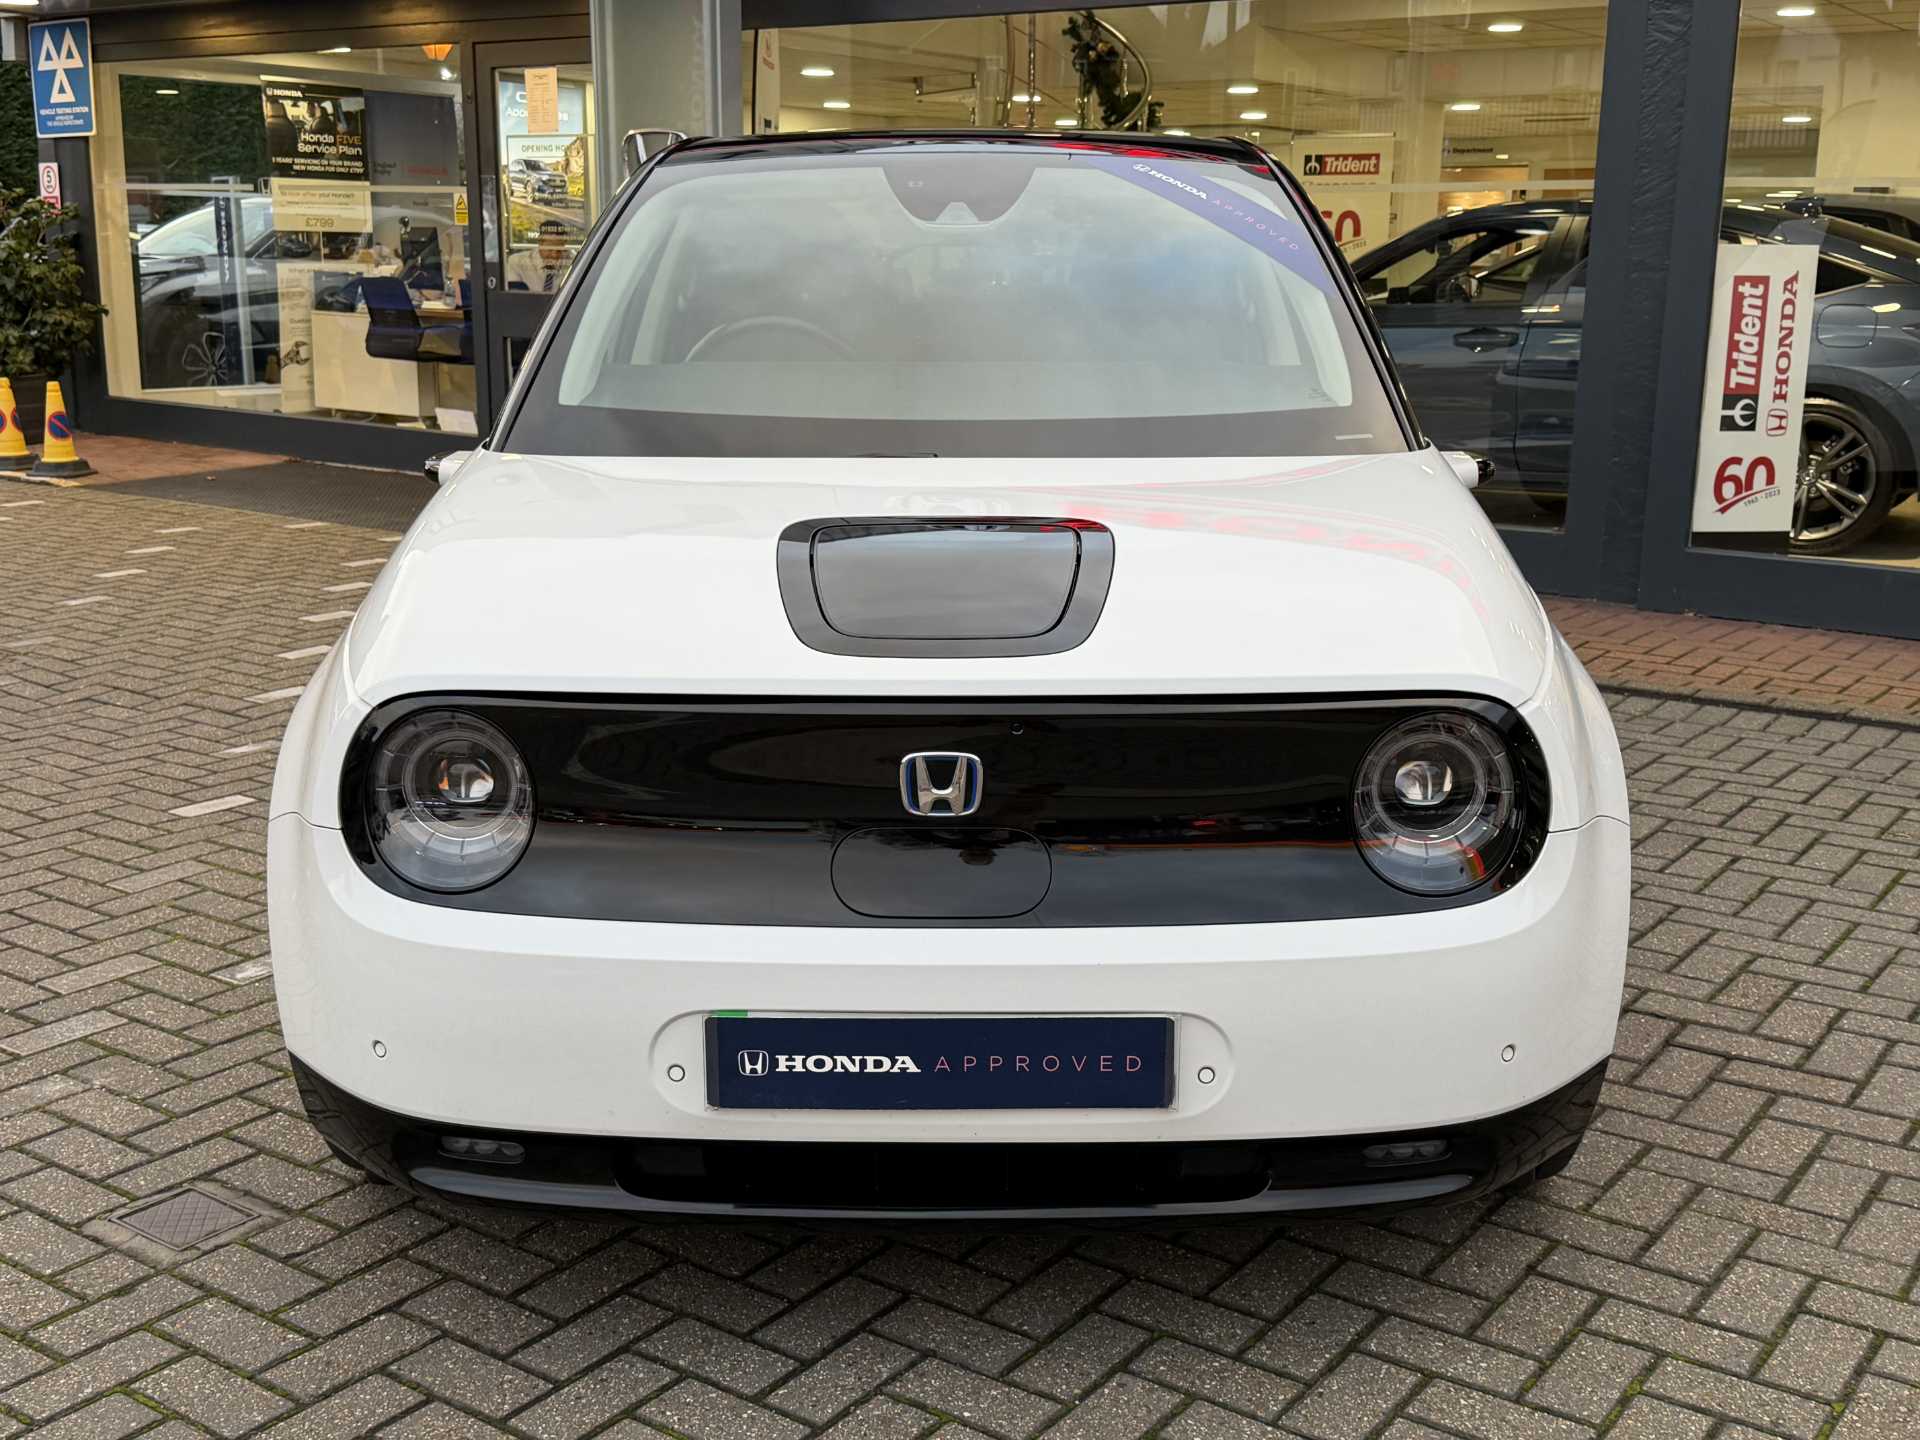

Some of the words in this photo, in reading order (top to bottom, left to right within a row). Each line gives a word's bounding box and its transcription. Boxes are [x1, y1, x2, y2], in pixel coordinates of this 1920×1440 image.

[273, 88, 303, 97] HONDA
[300, 132, 335, 143] Honda
[336, 135, 362, 145] FIVE
[297, 142, 337, 154] Service
[338, 145, 363, 155] Plan
[521, 144, 554, 152] OPENING
[1324, 155, 1378, 173] Trident
[1148, 168, 1208, 200] HONDA
[1211, 198, 1299, 250] APPROVED
[1728, 281, 1765, 390] Trident
[1772, 269, 1800, 403] HONDA
[775, 1054, 922, 1073] HONDA
[934, 1055, 1143, 1072] APPROVED
